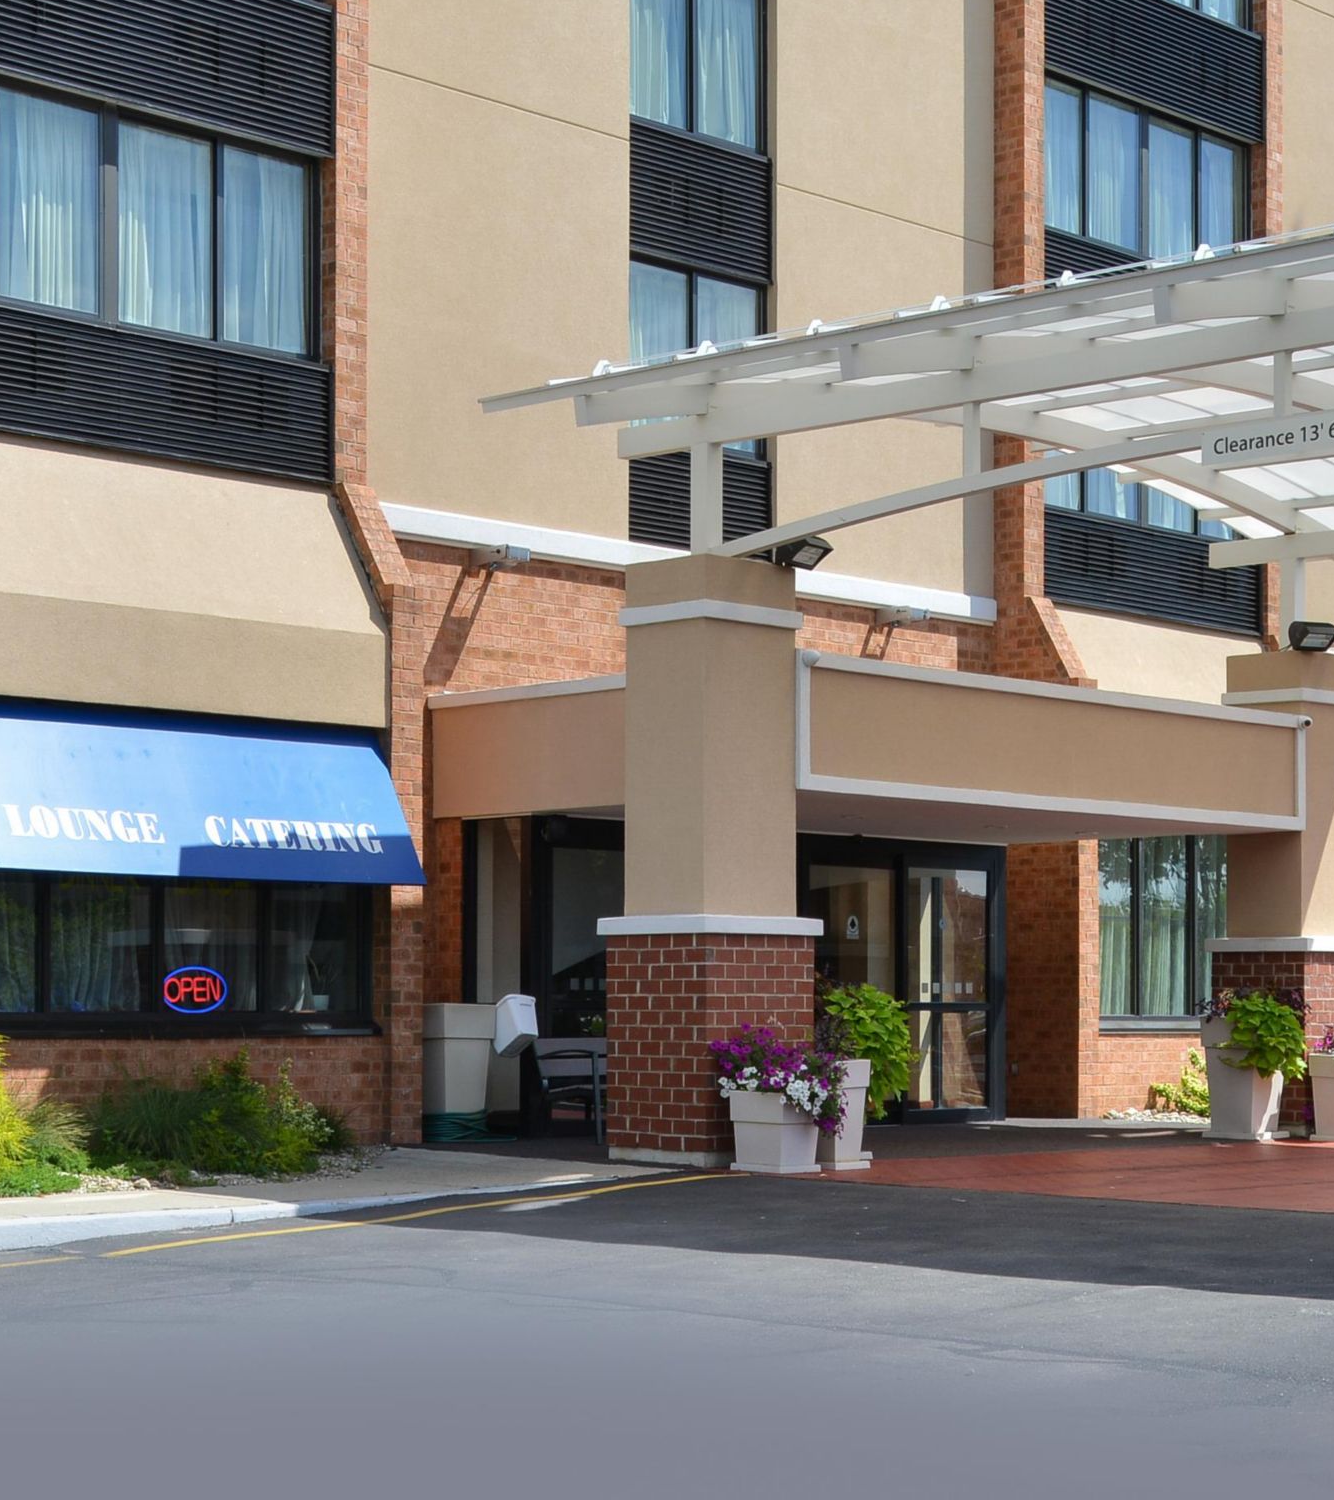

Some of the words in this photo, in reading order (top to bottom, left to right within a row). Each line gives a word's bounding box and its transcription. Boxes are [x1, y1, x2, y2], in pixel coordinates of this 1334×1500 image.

[1213, 428, 1295, 455] Clearance
[1299, 423, 1324, 443] 13'
[2, 803, 166, 845] LOUNGE
[204, 815, 384, 855] CATERING
[164, 976, 221, 1005] OPEN
